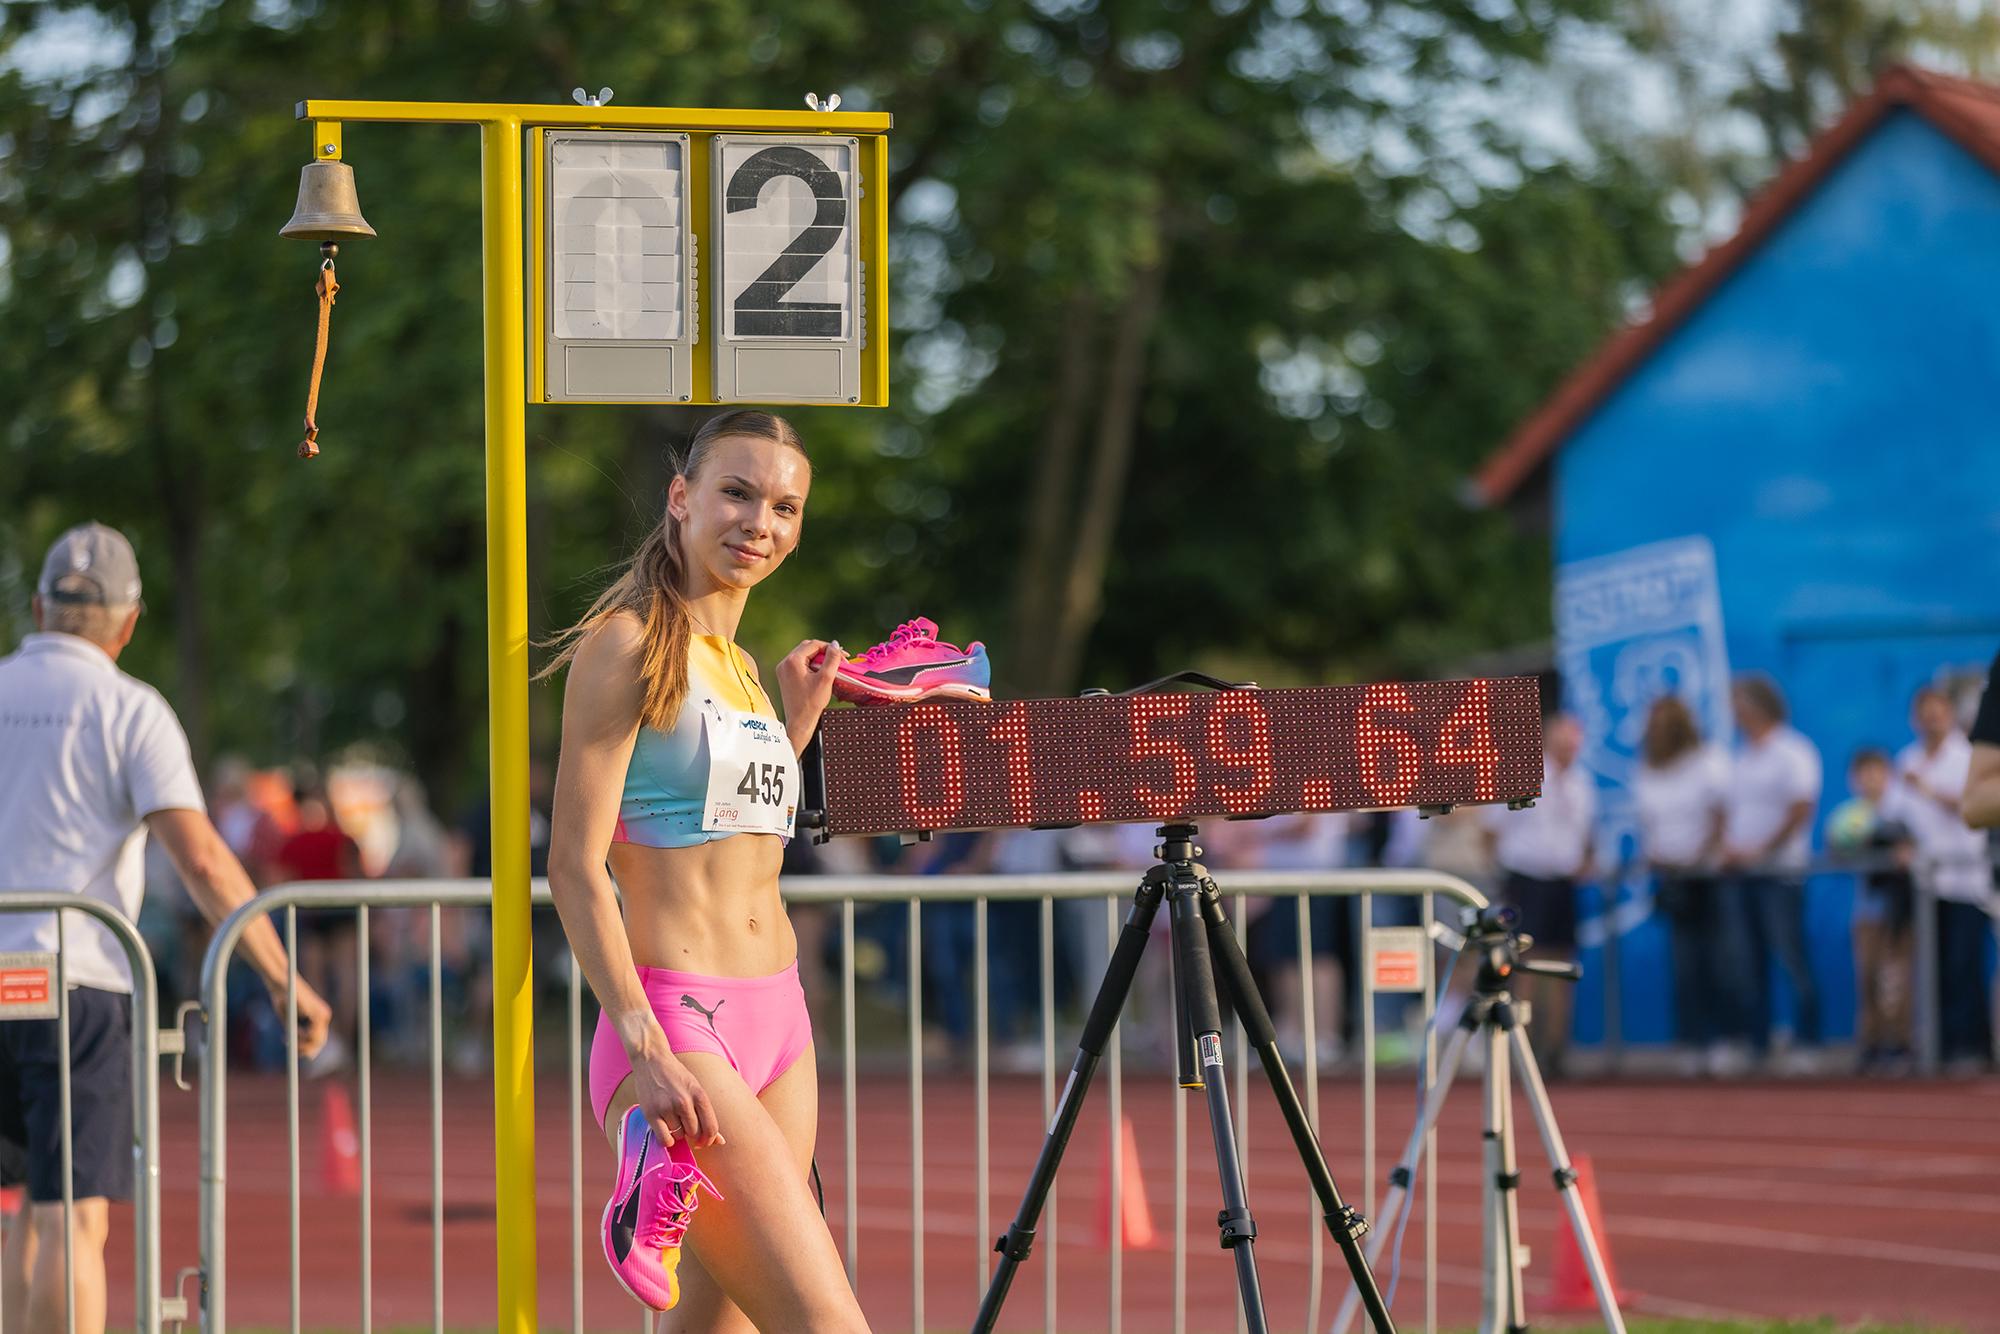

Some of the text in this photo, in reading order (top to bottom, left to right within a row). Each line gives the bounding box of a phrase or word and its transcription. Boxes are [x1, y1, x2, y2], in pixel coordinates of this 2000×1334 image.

[726, 146, 847, 336] 2
[736, 761, 785, 807] 455
[713, 807, 739, 821] Lang
